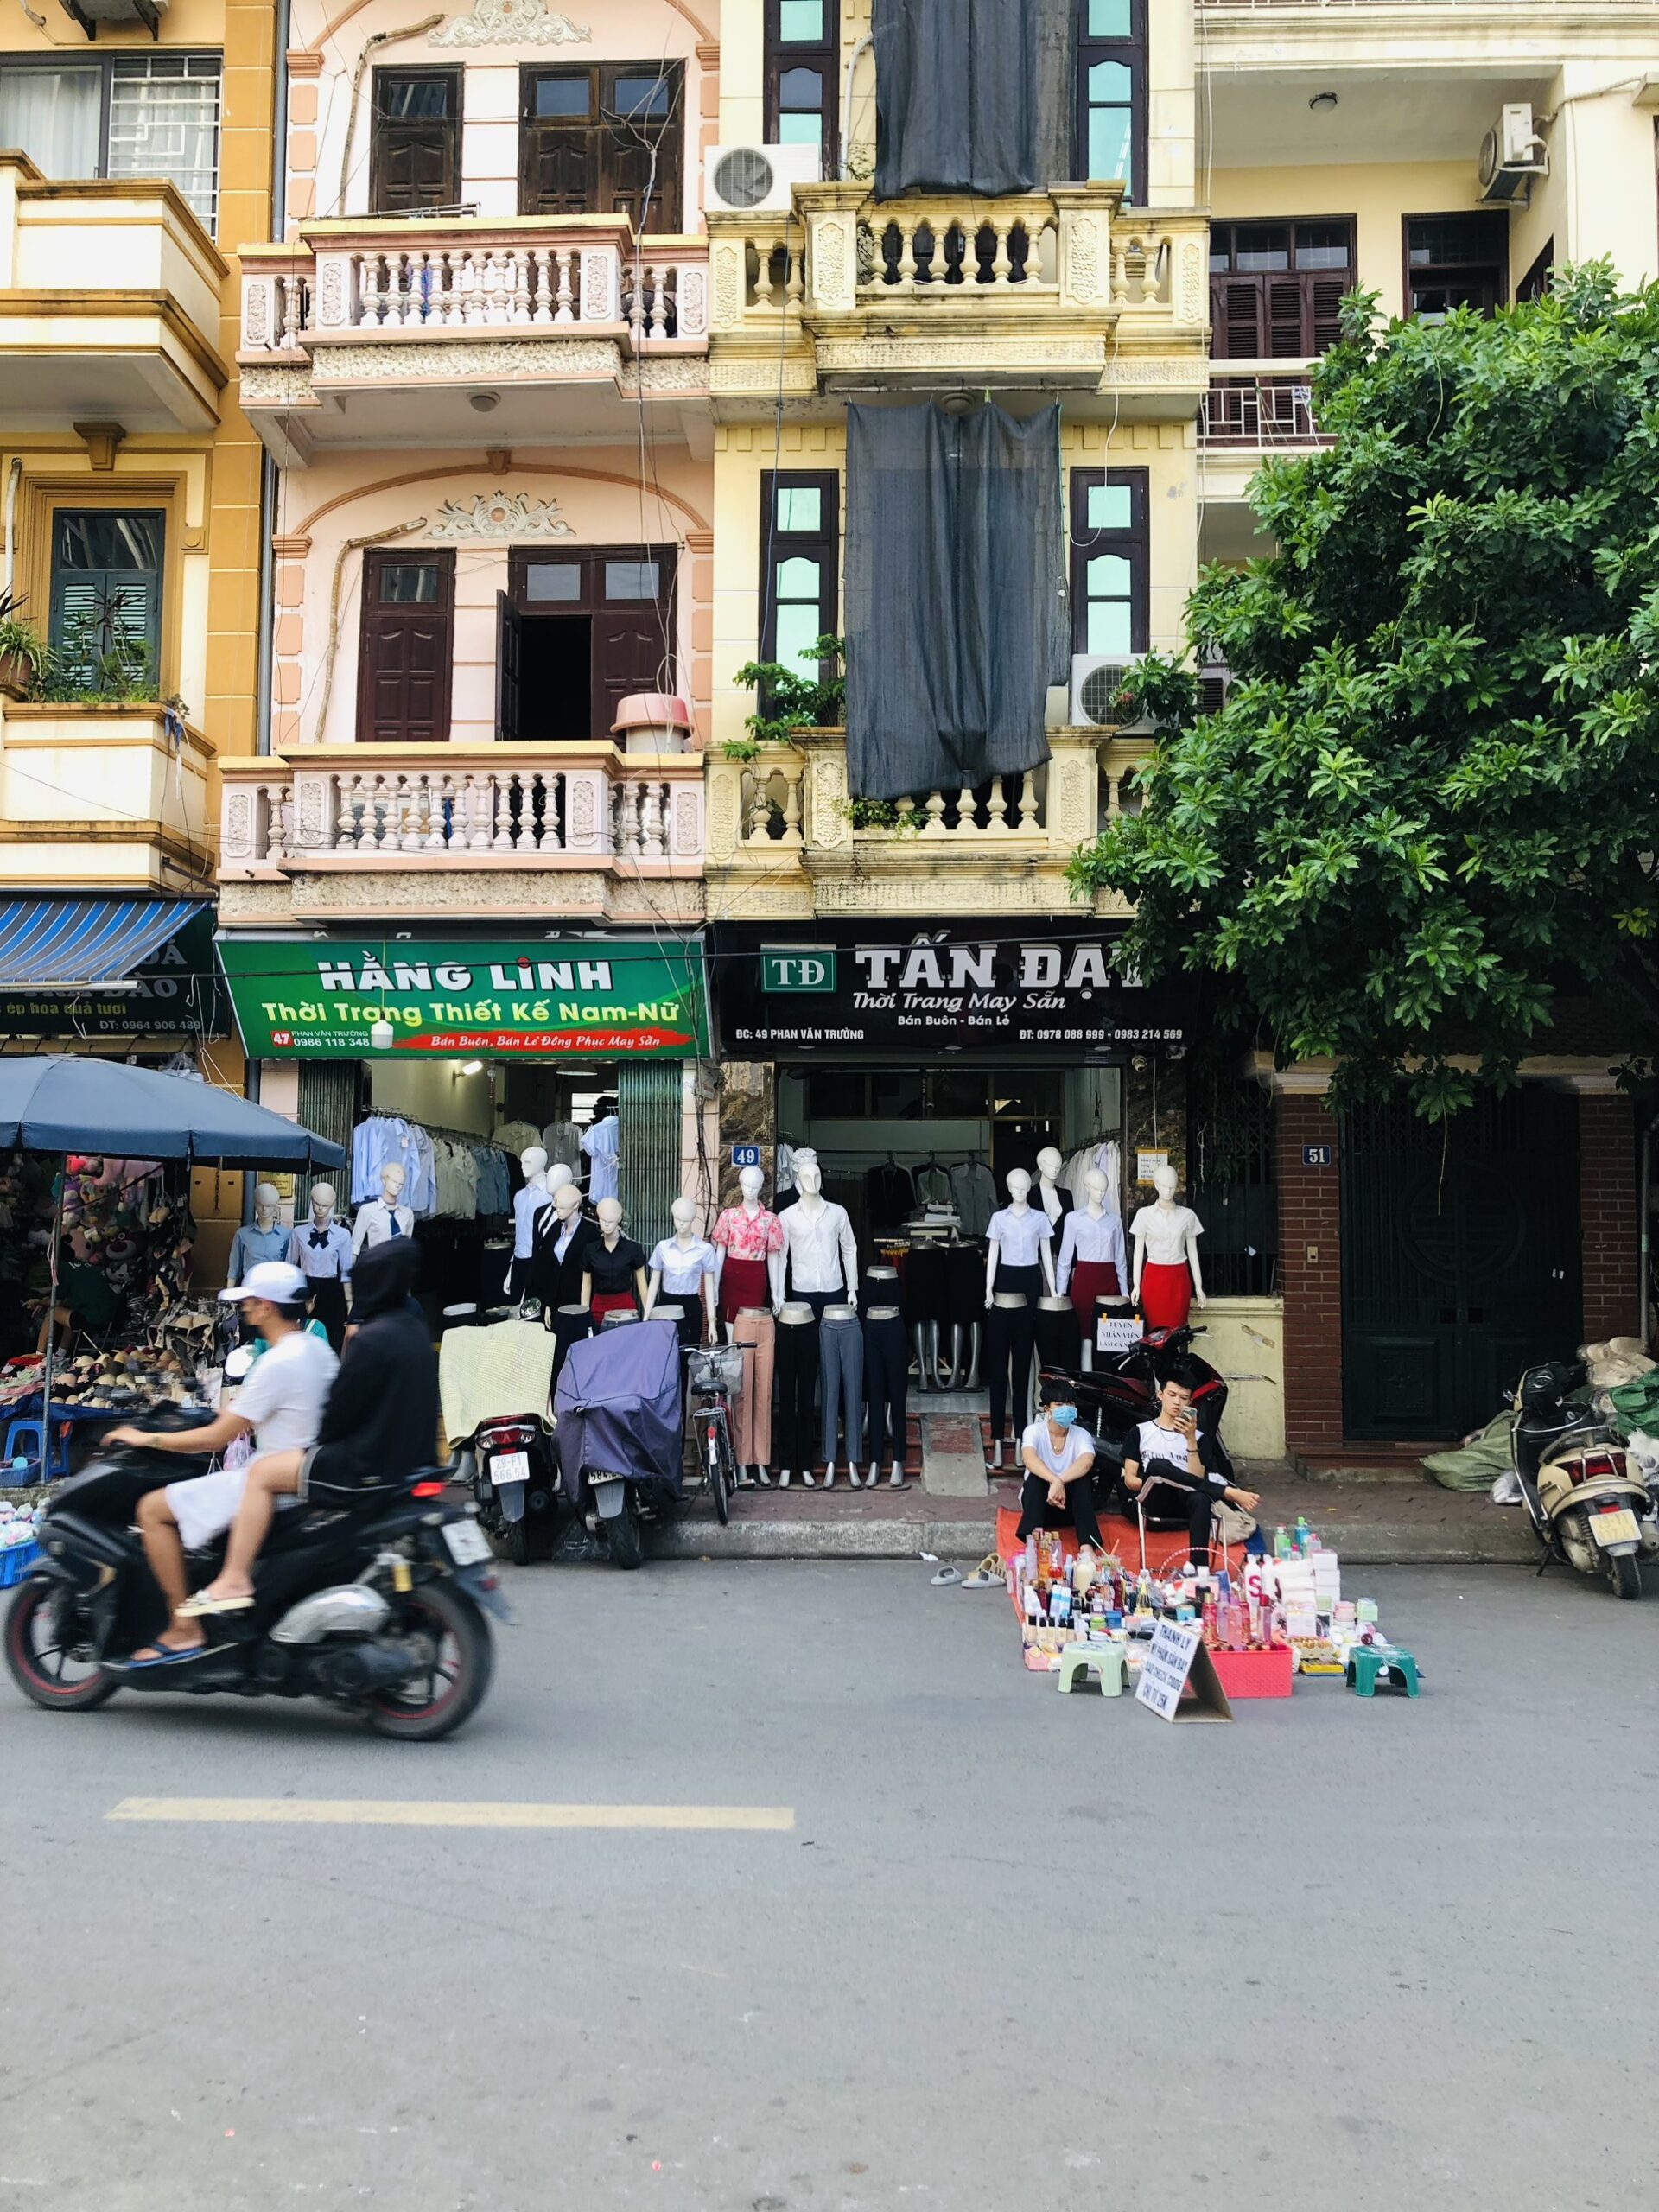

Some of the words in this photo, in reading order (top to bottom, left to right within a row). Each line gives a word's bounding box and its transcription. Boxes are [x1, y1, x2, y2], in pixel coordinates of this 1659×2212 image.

[855, 931, 996, 988] TẤN
[317, 950, 472, 991] HẰNG
[772, 959, 825, 985] TĐ
[7, 1002, 25, 1015] ép
[30, 1002, 59, 1014] hoa
[97, 1002, 127, 1014] tươi
[853, 992, 896, 1009] Thời
[903, 992, 963, 1013] Trang
[968, 993, 1017, 1013] May
[1022, 990, 1066, 1009] Sẵn
[261, 1001, 327, 1022] Thời
[334, 1002, 423, 1027] Trang
[429, 999, 502, 1022] Thiết
[512, 999, 551, 1022] Kế
[559, 1001, 680, 1022] Nam-Nữ
[898, 1014, 922, 1026] Bán
[925, 1014, 957, 1026] Buôn
[968, 1014, 993, 1026] Bán
[996, 1014, 1010, 1026] Lẻ
[99, 1021, 118, 1030] ĐT:
[122, 1021, 151, 1030] 0964
[154, 1021, 176, 1030] 906
[735, 1028, 753, 1039] ĐC:
[755, 1028, 768, 1039] 49
[770, 1028, 798, 1039] PHAN
[800, 1027, 822, 1039] VĂN
[824, 1027, 864, 1039] TRƯỜNG
[273, 1033, 289, 1045] 47
[1020, 1029, 1034, 1039] ĐT:
[1037, 1029, 1062, 1039] 0978
[1065, 1029, 1083, 1039] 088
[1085, 1029, 1105, 1039] 999
[1114, 1029, 1140, 1039] 0983
[1141, 1029, 1161, 1039] 214
[1163, 1029, 1183, 1039] 569
[294, 1038, 322, 1046] 0986
[325, 1038, 346, 1046] 118
[348, 1038, 370, 1046] 348
[431, 1035, 455, 1046] Bán
[459, 1035, 493, 1047] Buôn,
[497, 1035, 520, 1046] Bán
[524, 1035, 540, 1046] Lẻ
[541, 1035, 572, 1049] Đồng
[576, 1035, 605, 1048] Phục
[608, 1035, 635, 1049] May
[737, 1149, 755, 1164] 49
[1309, 1147, 1325, 1163] 51
[493, 1468, 527, 1483] 566.54
[1160, 1624, 1182, 1646] THANH
